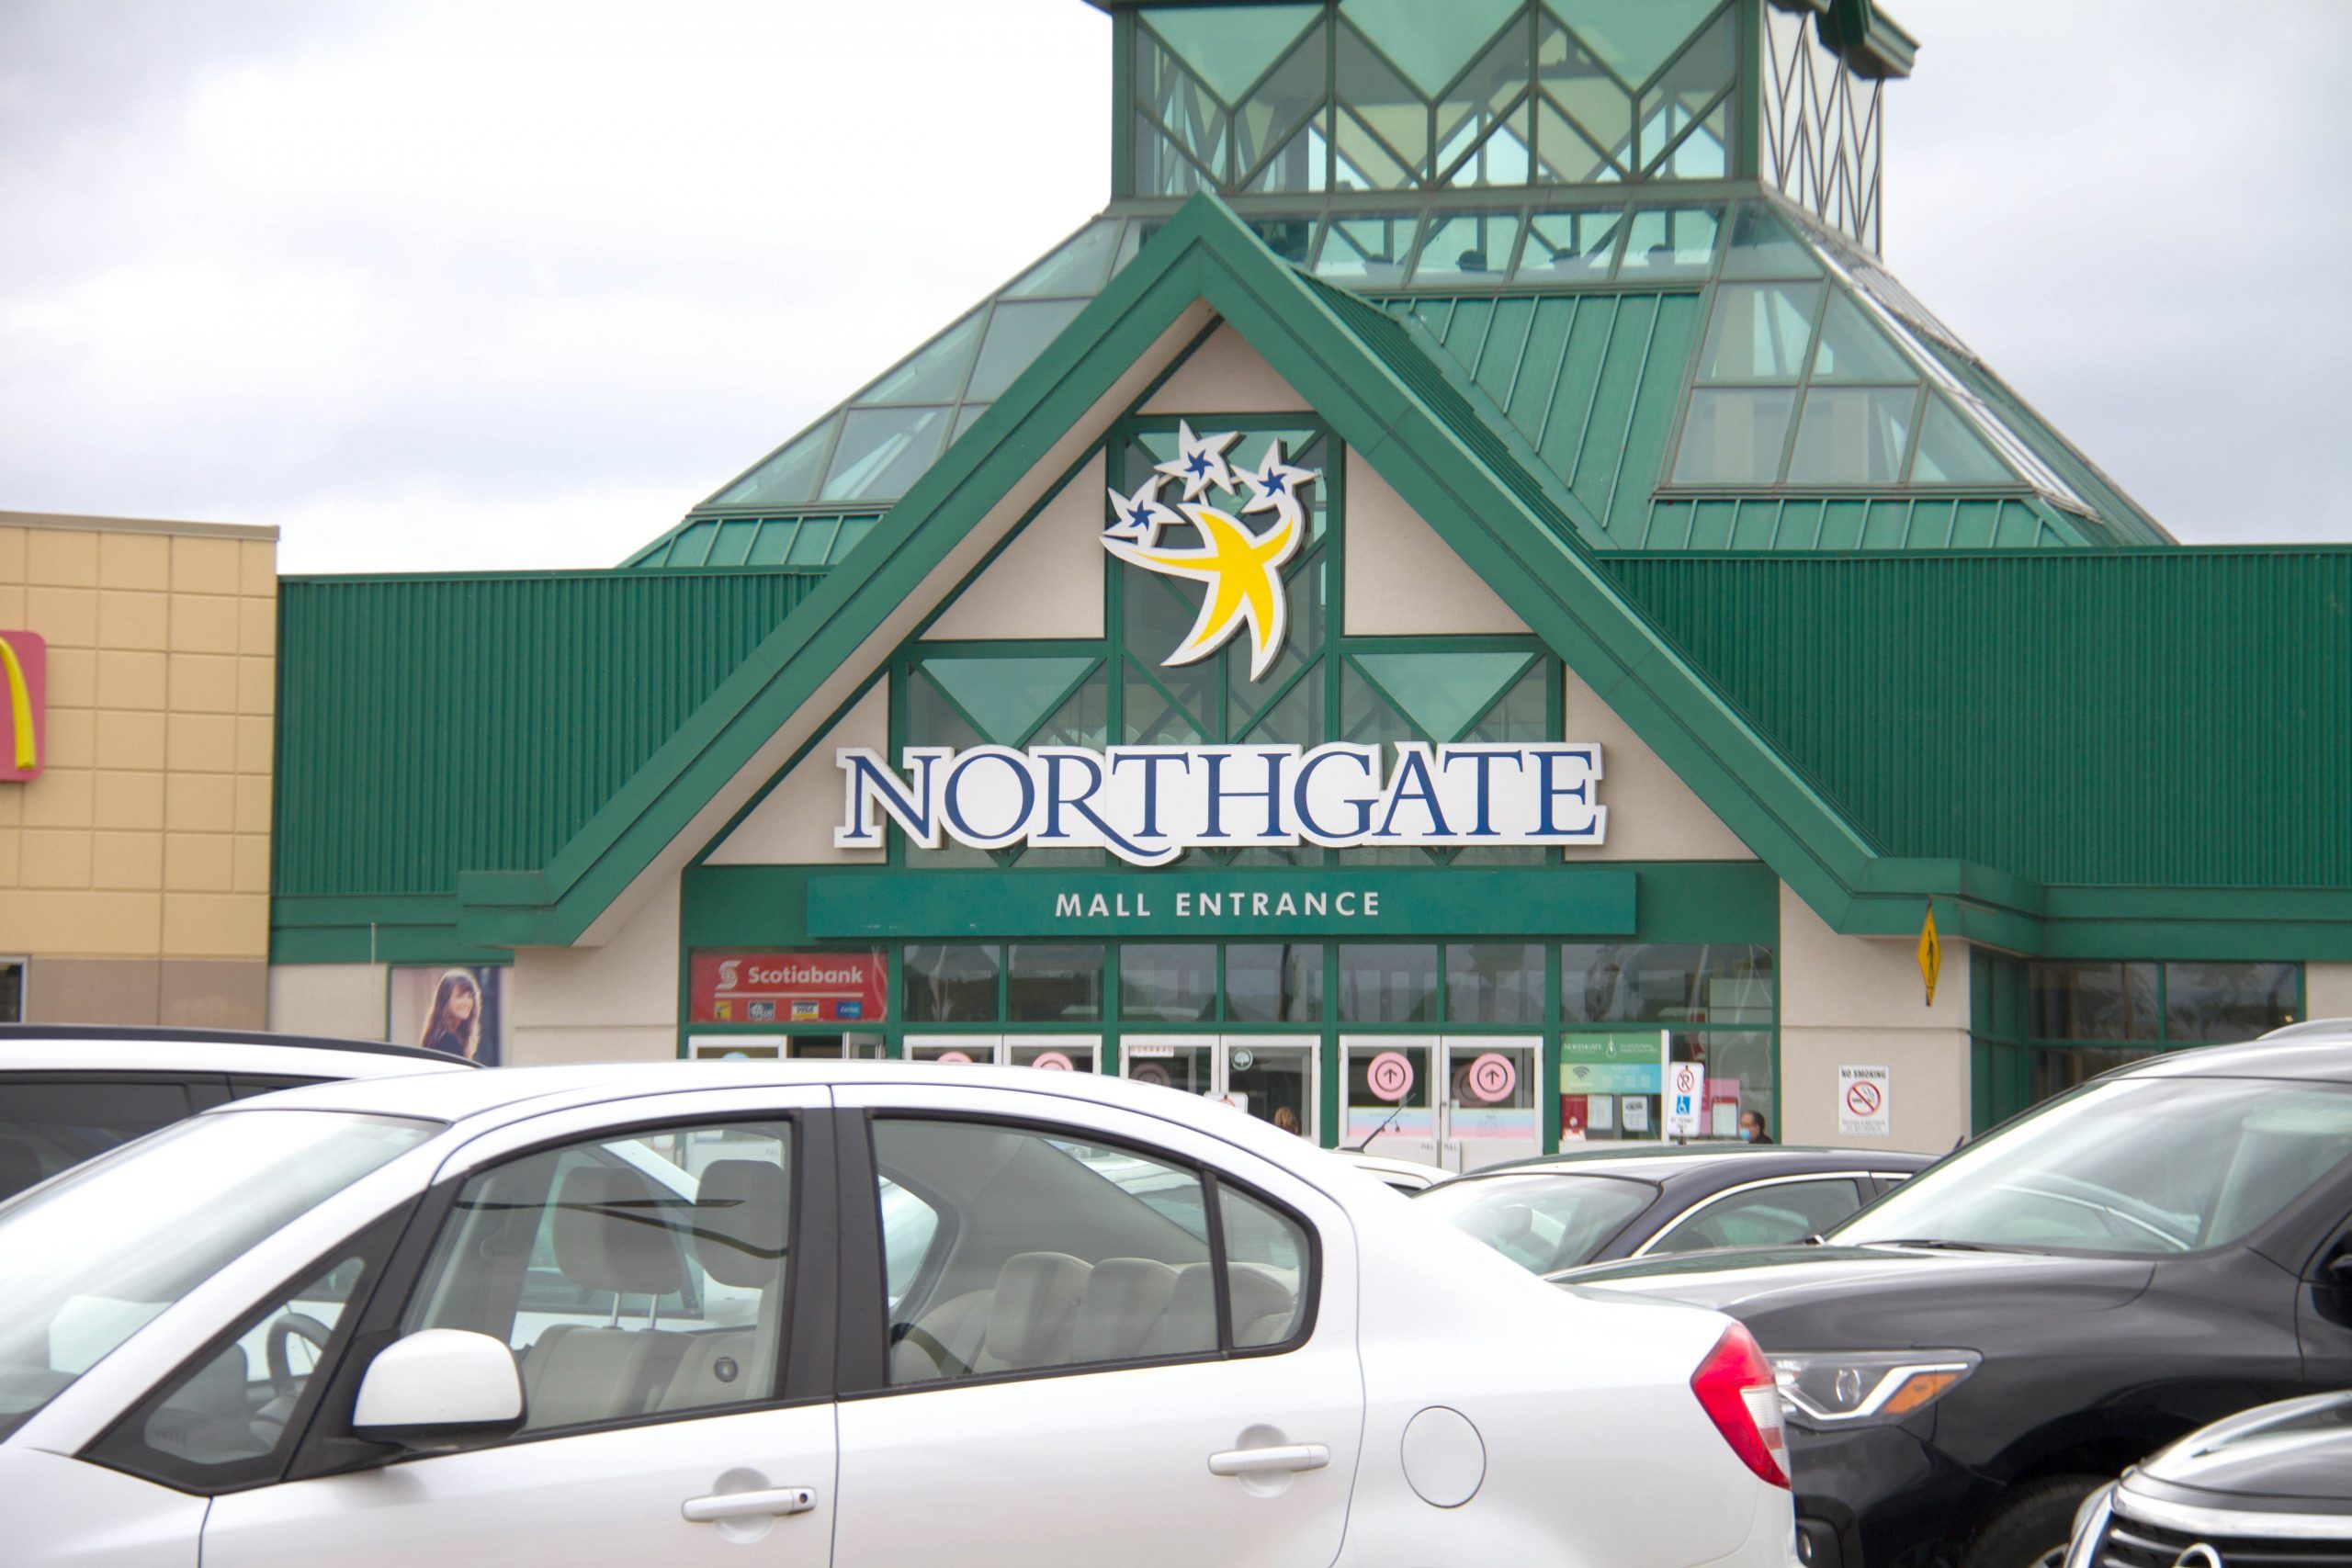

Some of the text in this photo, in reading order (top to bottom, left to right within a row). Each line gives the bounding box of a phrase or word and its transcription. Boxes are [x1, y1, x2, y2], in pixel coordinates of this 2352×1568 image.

[842, 750, 1597, 857] NORTHGATE
[1055, 891, 1379, 917] MALL ENTRANCE
[748, 964, 863, 984] Scotiabank
[1840, 1068, 1886, 1079] NO SMOKING
